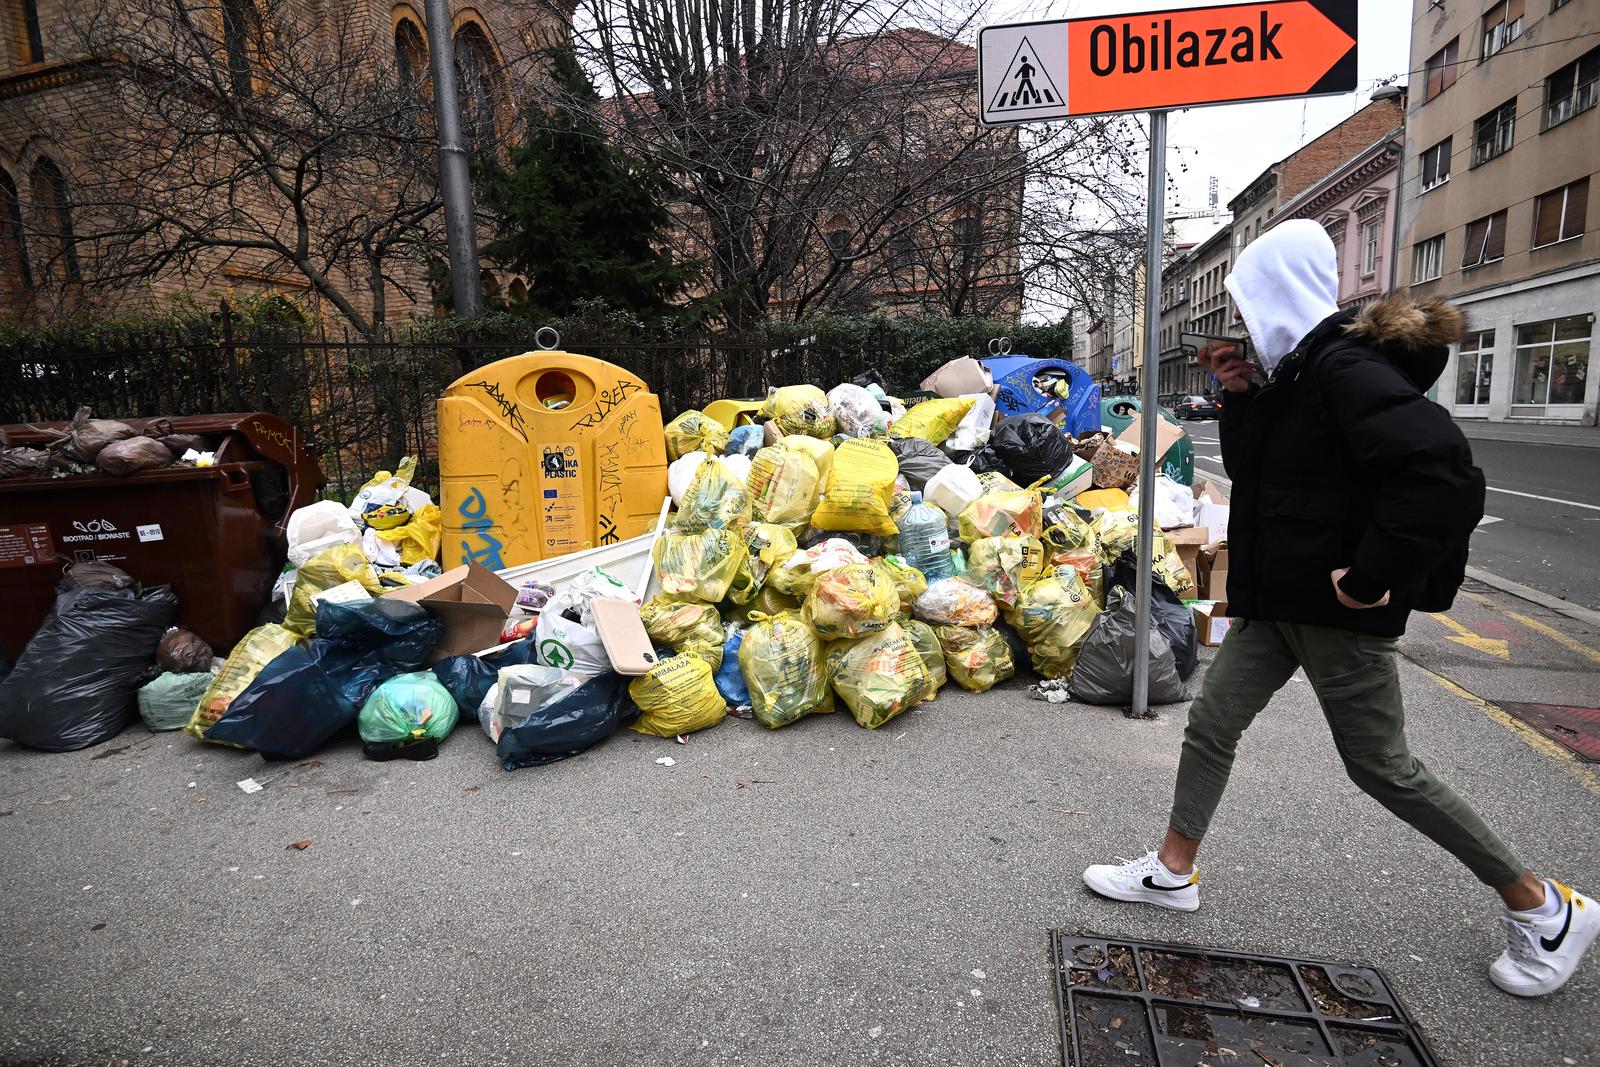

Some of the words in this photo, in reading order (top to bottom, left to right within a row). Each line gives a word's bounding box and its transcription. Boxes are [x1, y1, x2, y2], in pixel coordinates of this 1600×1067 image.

[1090, 11, 1283, 77] Obilazak
[545, 469, 577, 479] PLASTIC
[98, 532, 131, 541] BIOWASTE
